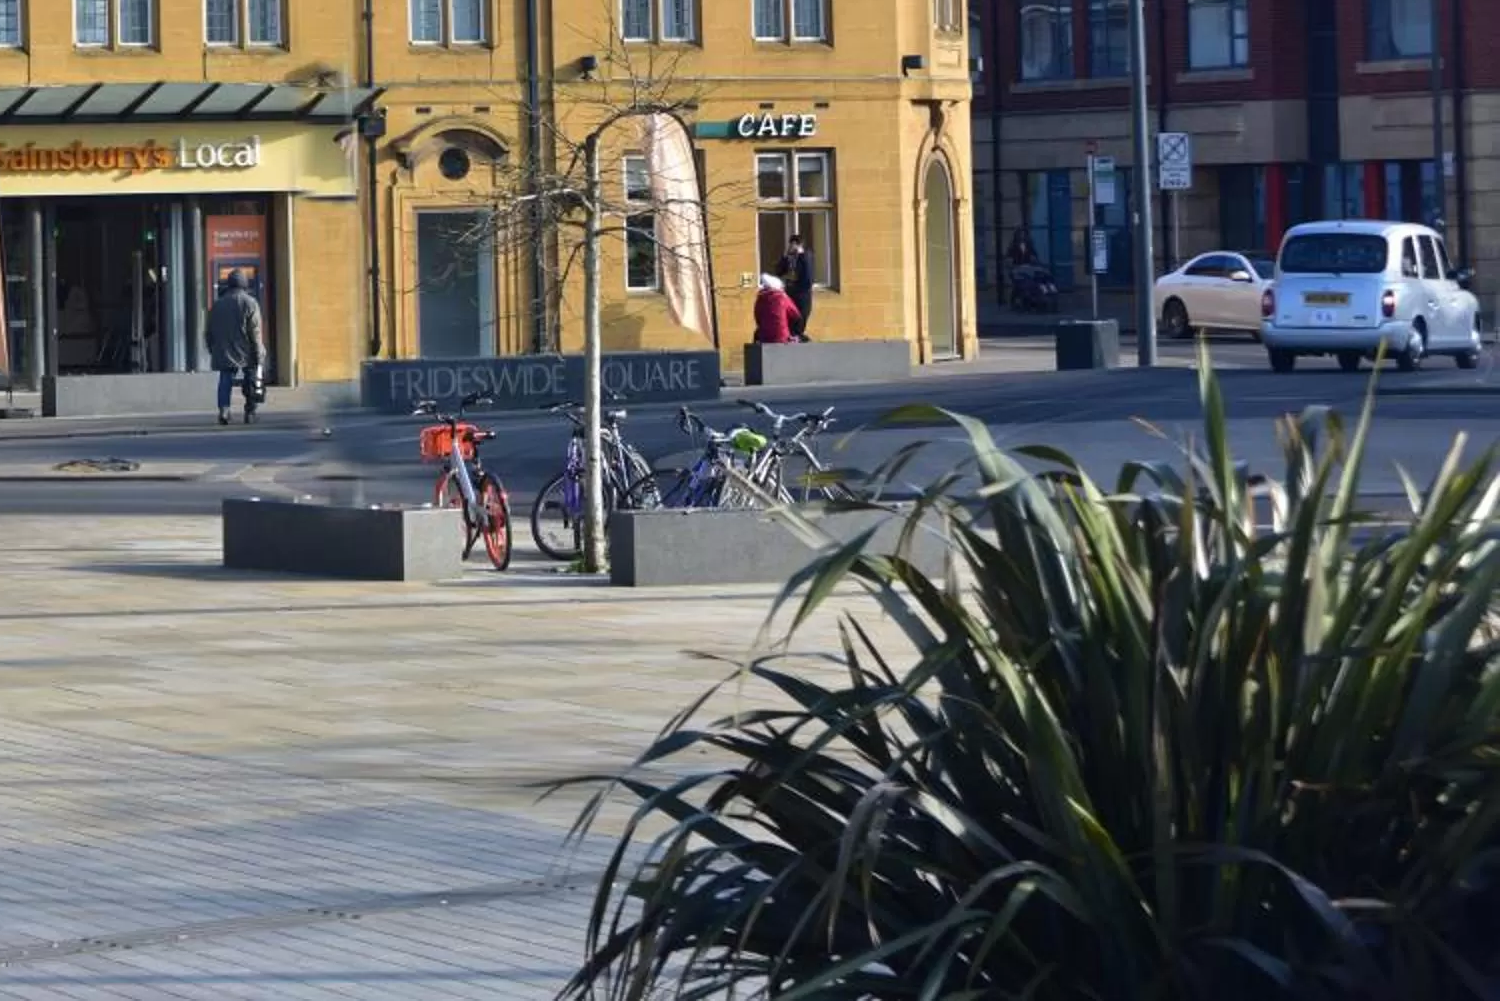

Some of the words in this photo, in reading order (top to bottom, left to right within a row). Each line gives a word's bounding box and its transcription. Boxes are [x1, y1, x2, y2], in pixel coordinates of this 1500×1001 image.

[737, 112, 817, 137] CAFE
[179, 135, 261, 167] Local
[389, 362, 567, 400] FRIDESWIDE
[594, 358, 700, 395] QUARE
